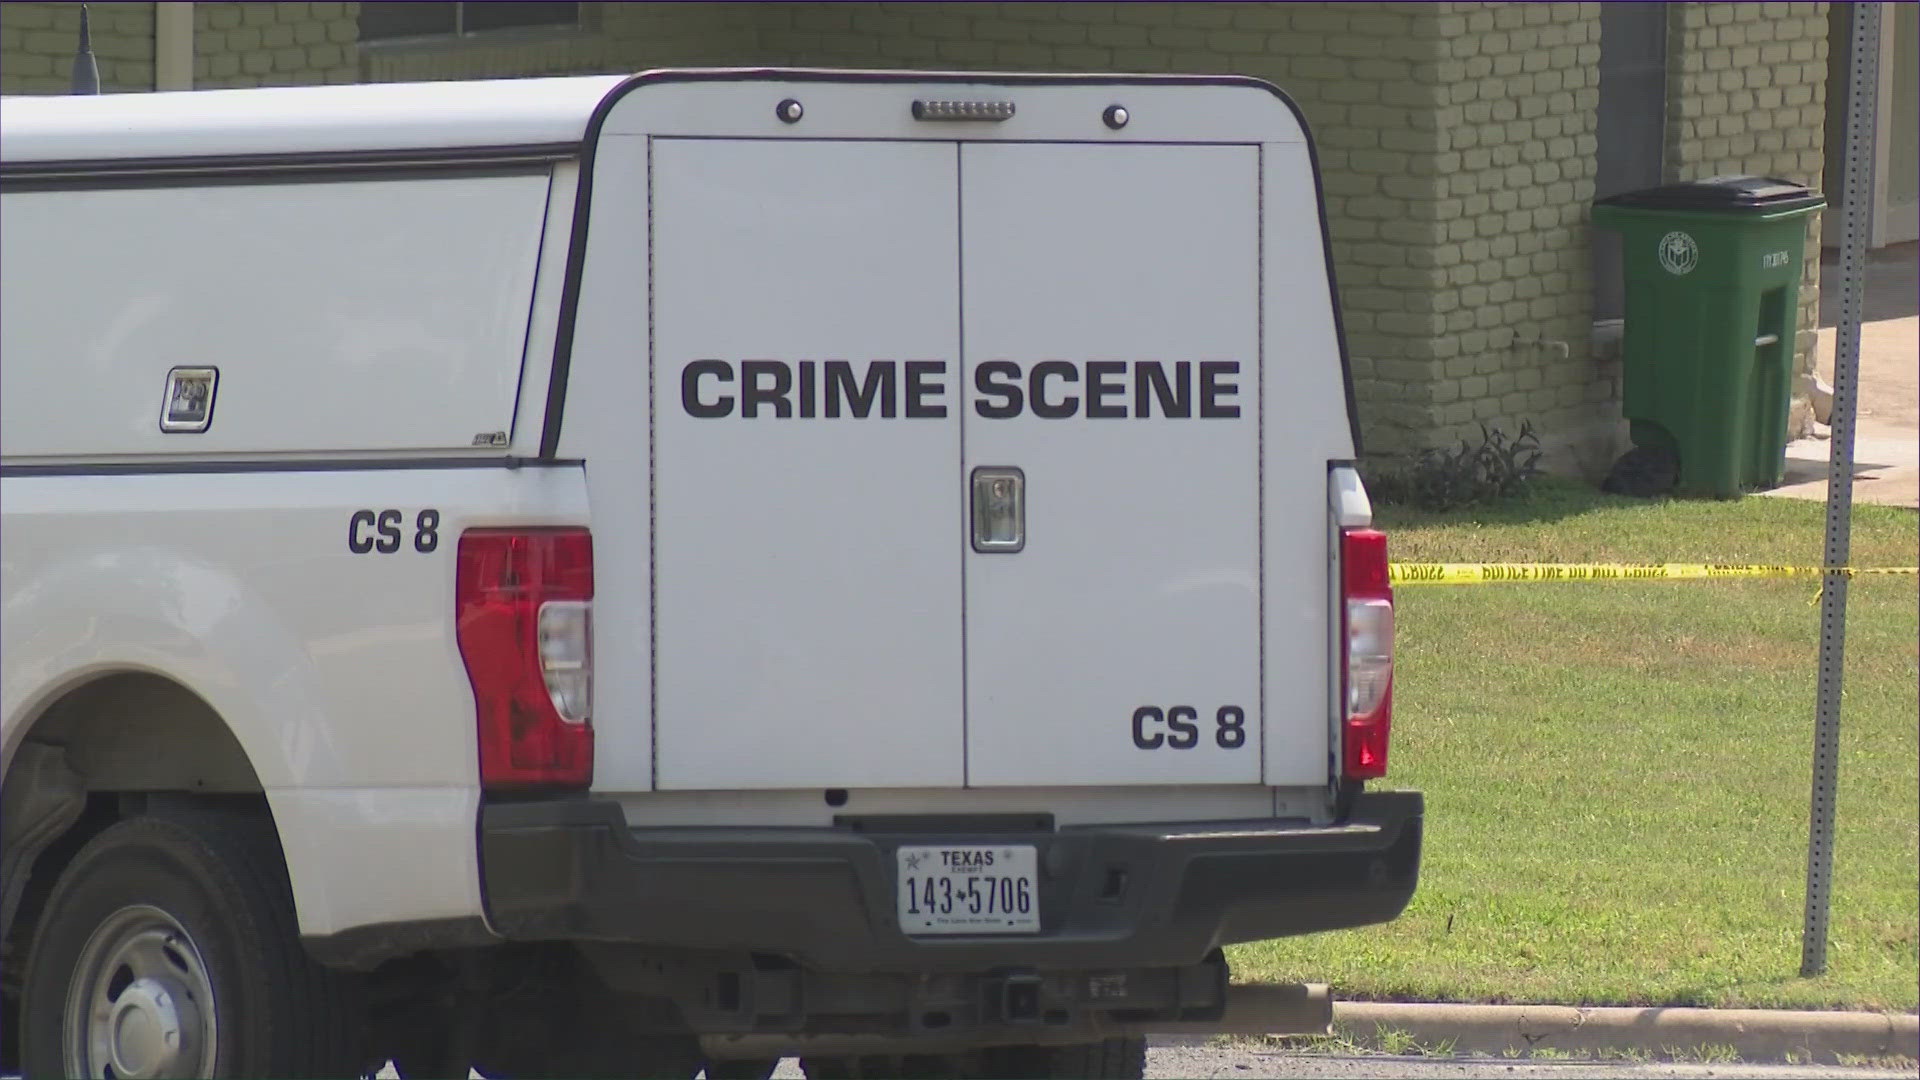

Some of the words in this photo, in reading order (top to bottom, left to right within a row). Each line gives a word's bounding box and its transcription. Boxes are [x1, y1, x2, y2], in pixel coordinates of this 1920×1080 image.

[681, 359, 947, 419] CRIME
[975, 359, 1240, 419] SCENE
[349, 509, 402, 554] CS
[414, 509, 440, 553] 8
[1132, 705, 1199, 750] CS
[1216, 705, 1245, 750] 8
[941, 851, 994, 866] TEXAS
